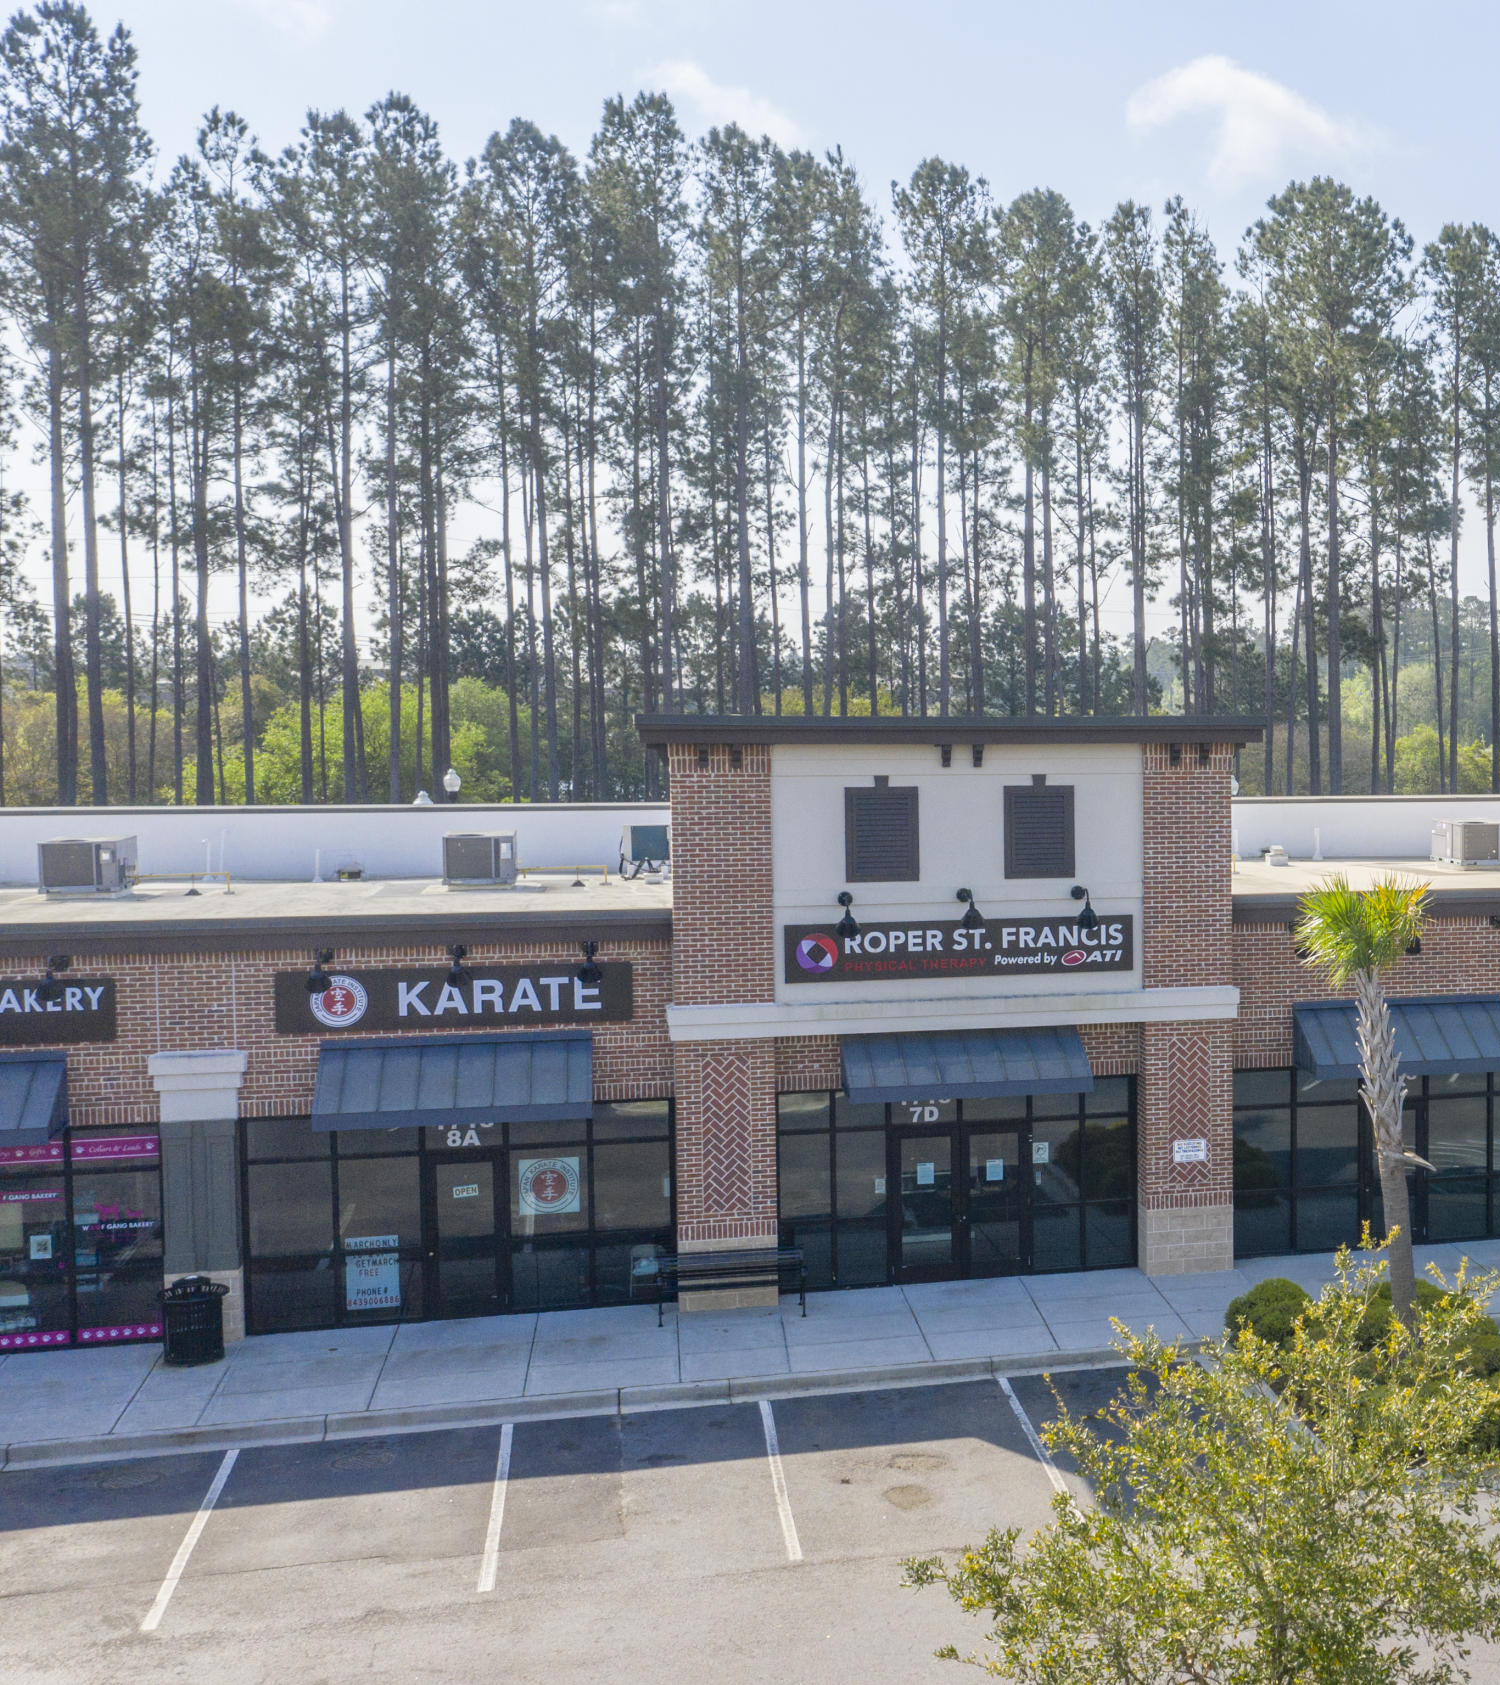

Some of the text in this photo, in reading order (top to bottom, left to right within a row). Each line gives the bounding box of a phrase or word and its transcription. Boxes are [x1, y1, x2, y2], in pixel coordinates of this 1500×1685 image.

[845, 923, 1123, 954] ROPER ST. FRANCIS
[994, 953, 1058, 966] Powered by
[1086, 950, 1122, 963] ATI
[844, 957, 988, 973] PHYSICAL THERAPY
[398, 977, 602, 1016] KARATE
[909, 1106, 940, 1123] 7D
[446, 1129, 481, 1147] 8A
[454, 1186, 478, 1197] OPEN
[106, 1222, 128, 1230] GANG
